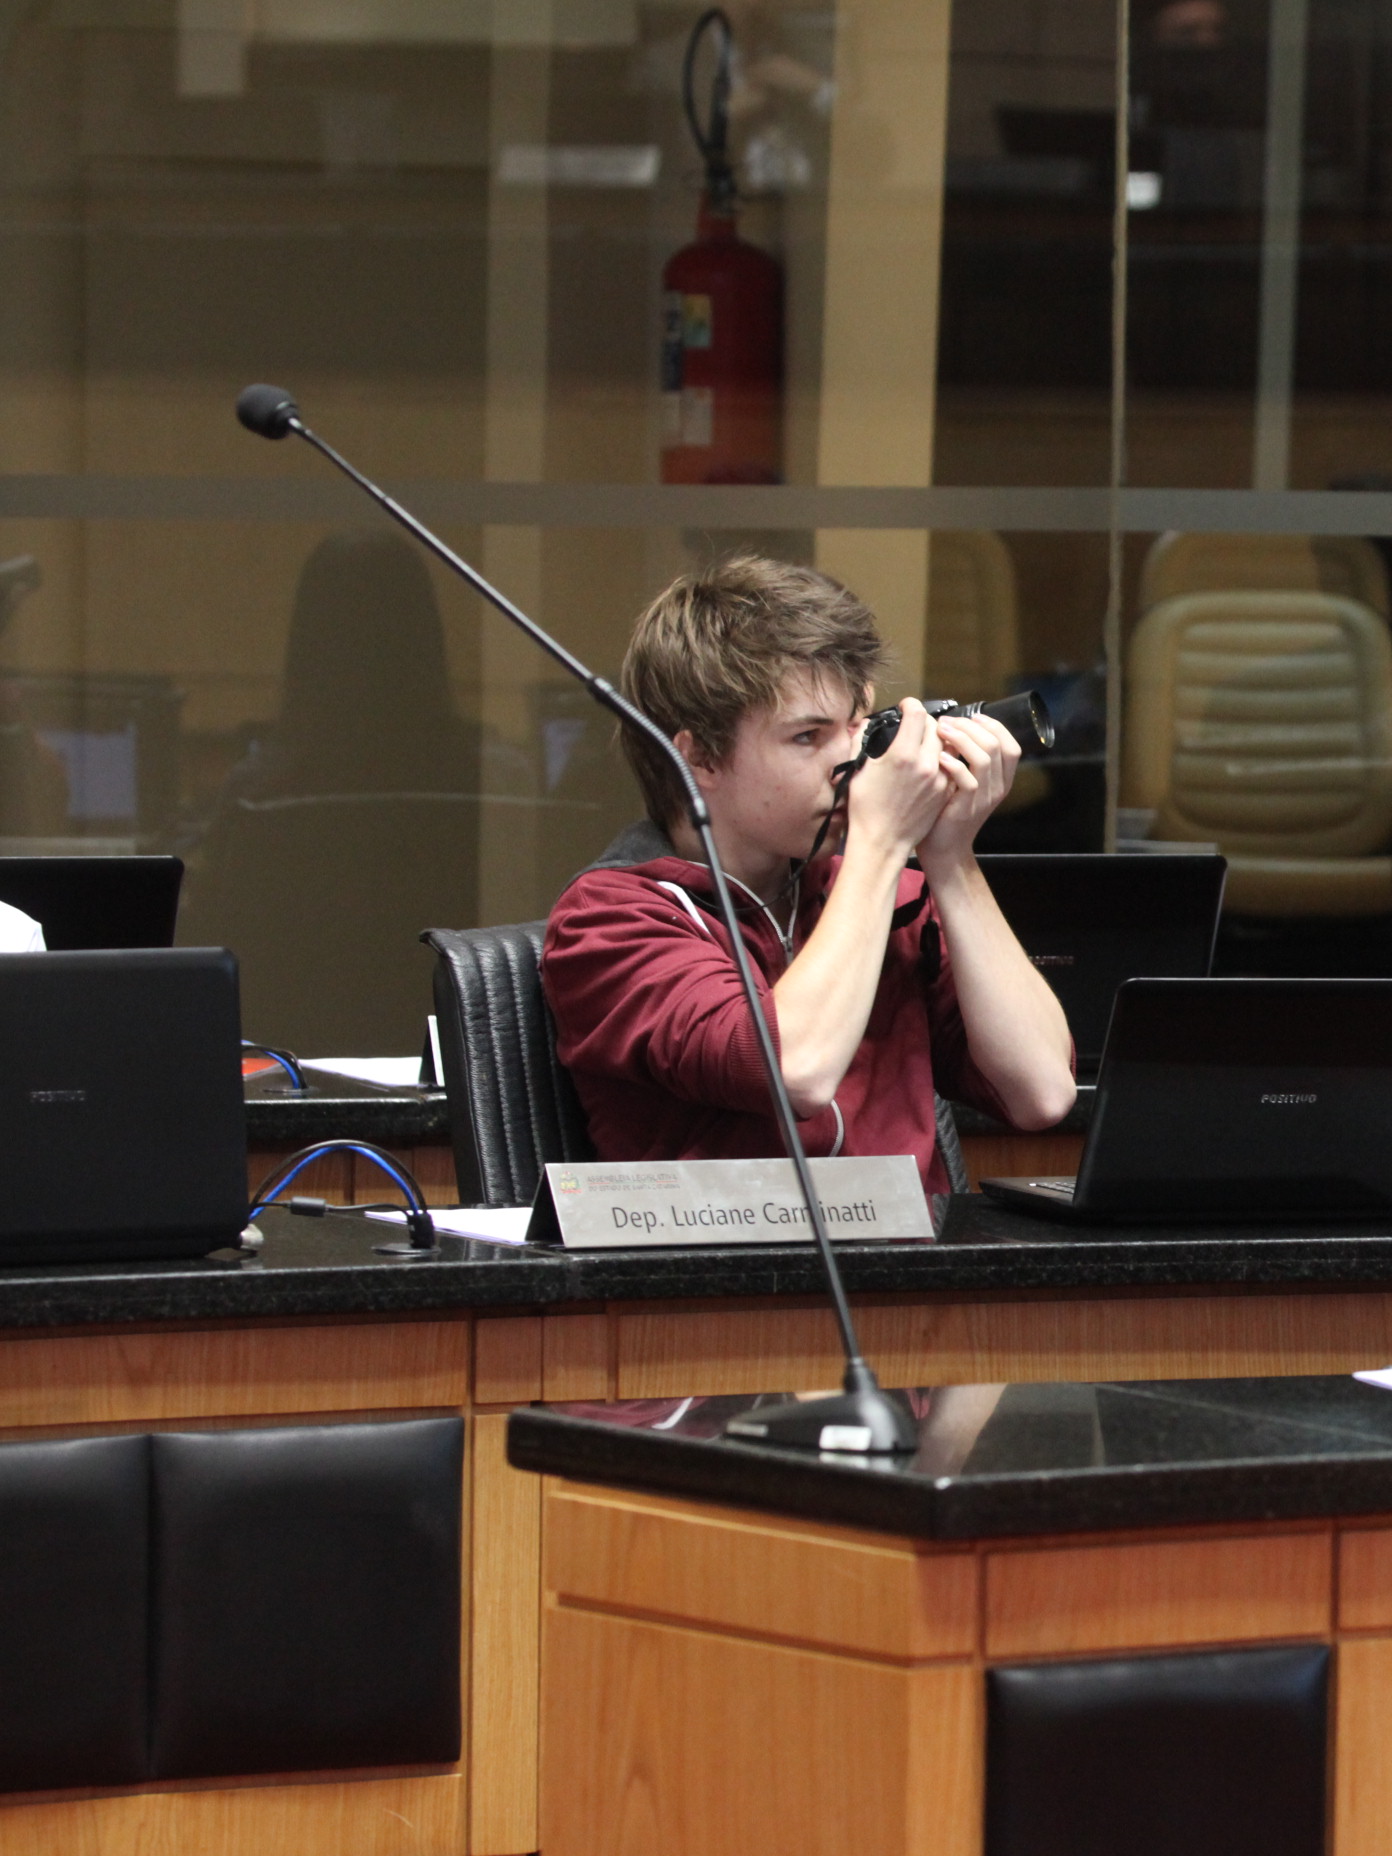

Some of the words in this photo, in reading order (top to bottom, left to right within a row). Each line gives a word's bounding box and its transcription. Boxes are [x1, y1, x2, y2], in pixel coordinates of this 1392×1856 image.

[1261, 1094, 1317, 1104] POSITIVO
[611, 1206, 665, 1233] Dep.
[671, 1203, 756, 1228] Luciane
